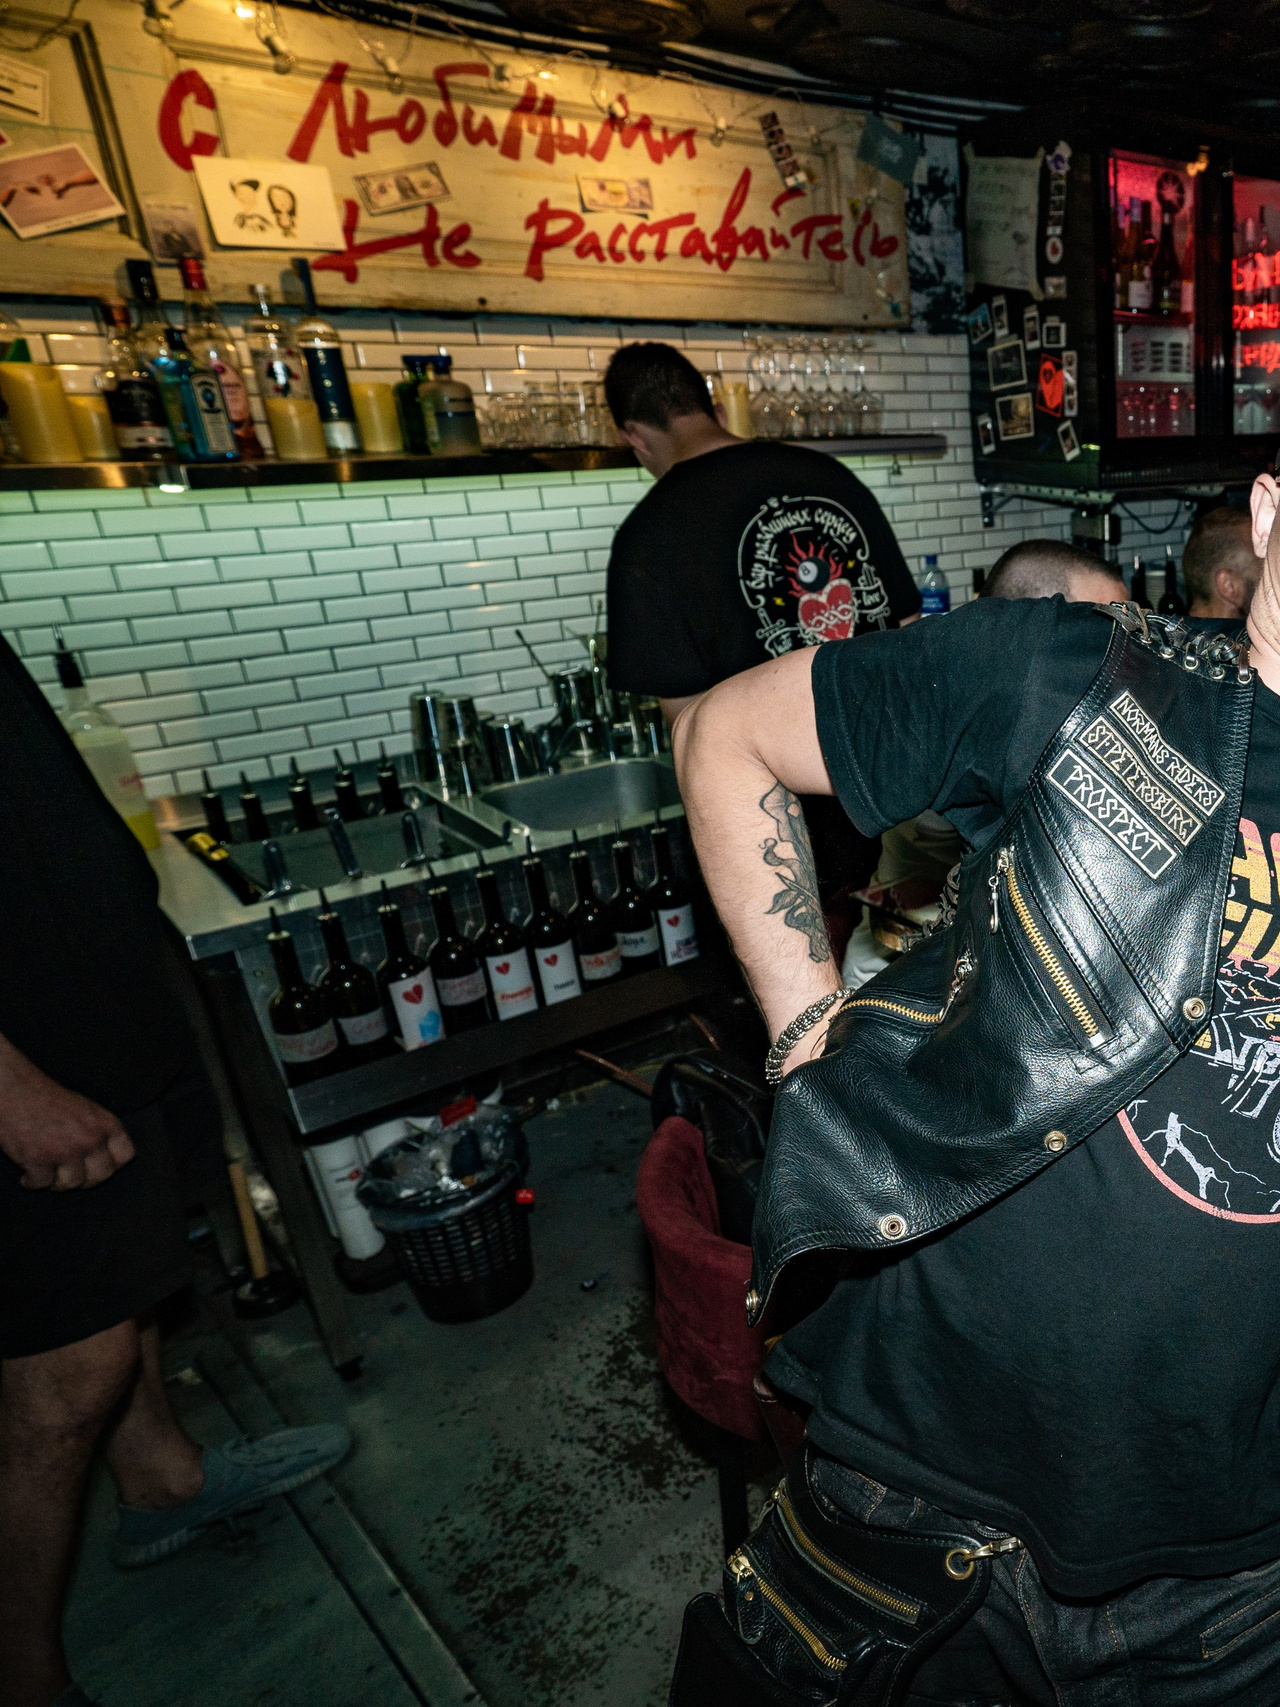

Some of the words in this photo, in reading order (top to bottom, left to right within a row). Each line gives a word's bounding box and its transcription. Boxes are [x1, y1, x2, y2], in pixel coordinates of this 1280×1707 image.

[312, 199, 482, 283] Не
[1116, 697, 1170, 765] NORMANS
[1166, 756, 1217, 807] RIDERS
[1063, 764, 1162, 860] PROSPECT
